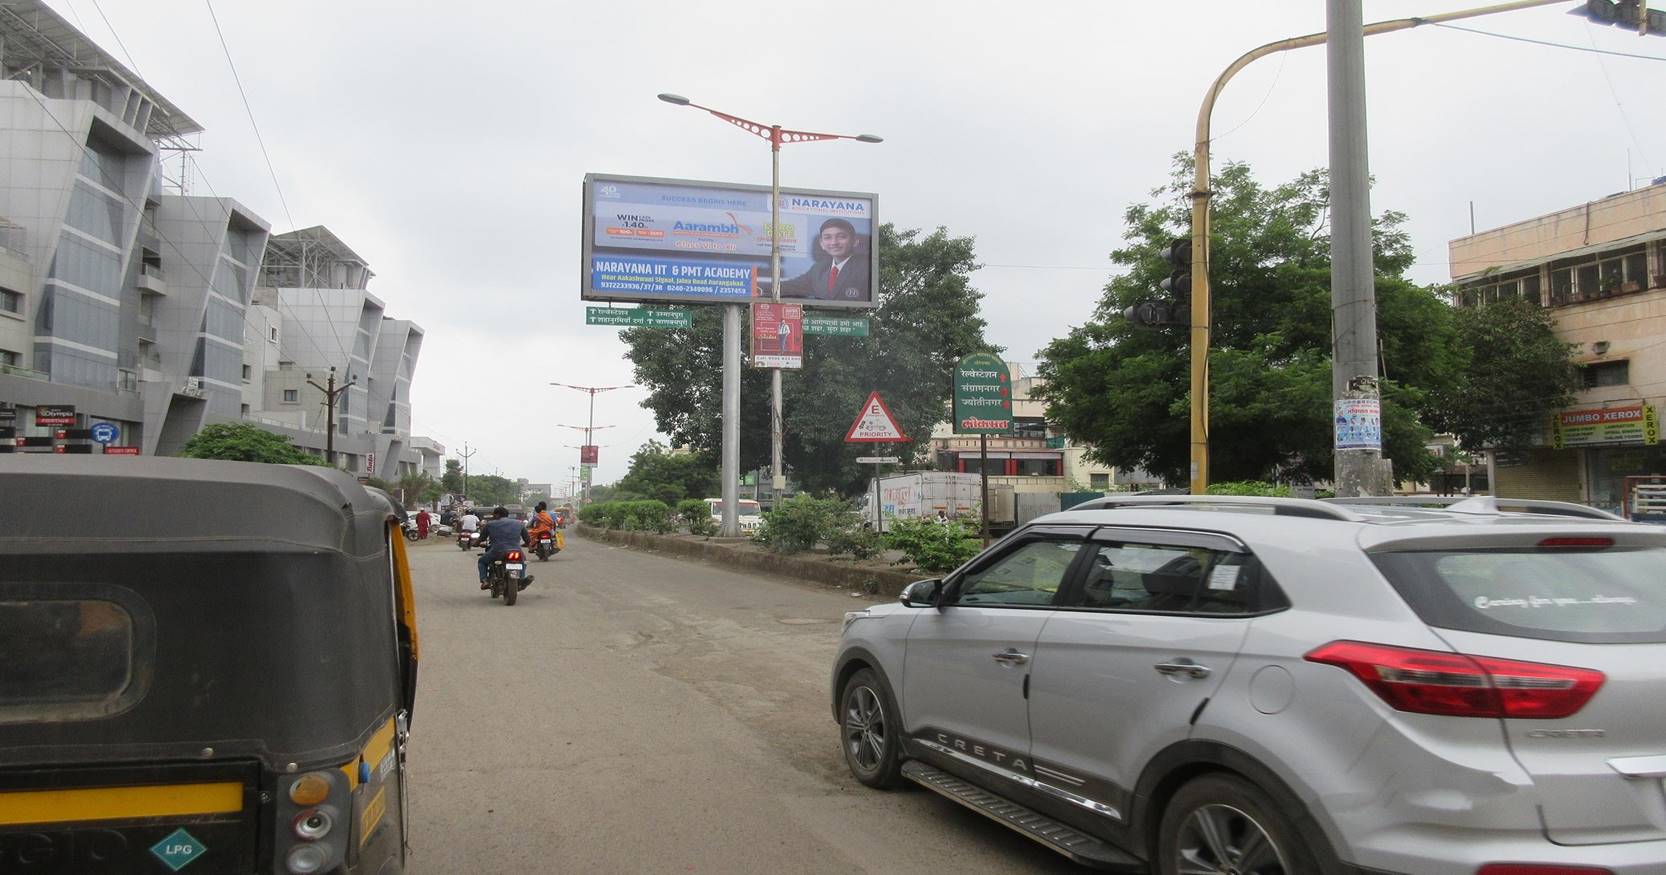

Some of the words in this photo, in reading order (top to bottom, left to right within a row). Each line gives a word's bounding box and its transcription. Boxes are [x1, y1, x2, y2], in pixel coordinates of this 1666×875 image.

[792, 198, 864, 211] NARAYANA
[674, 221, 739, 234] Aarambh
[596, 261, 651, 274] NARAYANA
[654, 263, 668, 275] IIT
[671, 265, 679, 276] &
[681, 266, 702, 277] PMT
[704, 267, 751, 279] ACADEMY
[961, 384, 1000, 393] संग्रामनगर
[871, 405, 880, 415] E
[1563, 413, 1600, 423] JUMBO
[1603, 410, 1641, 420] XEROX
[961, 416, 1009, 429] लोकमत
[1646, 406, 1656, 444] XEROX
[937, 733, 1028, 771] CRETA
[166, 844, 193, 855] LPG
